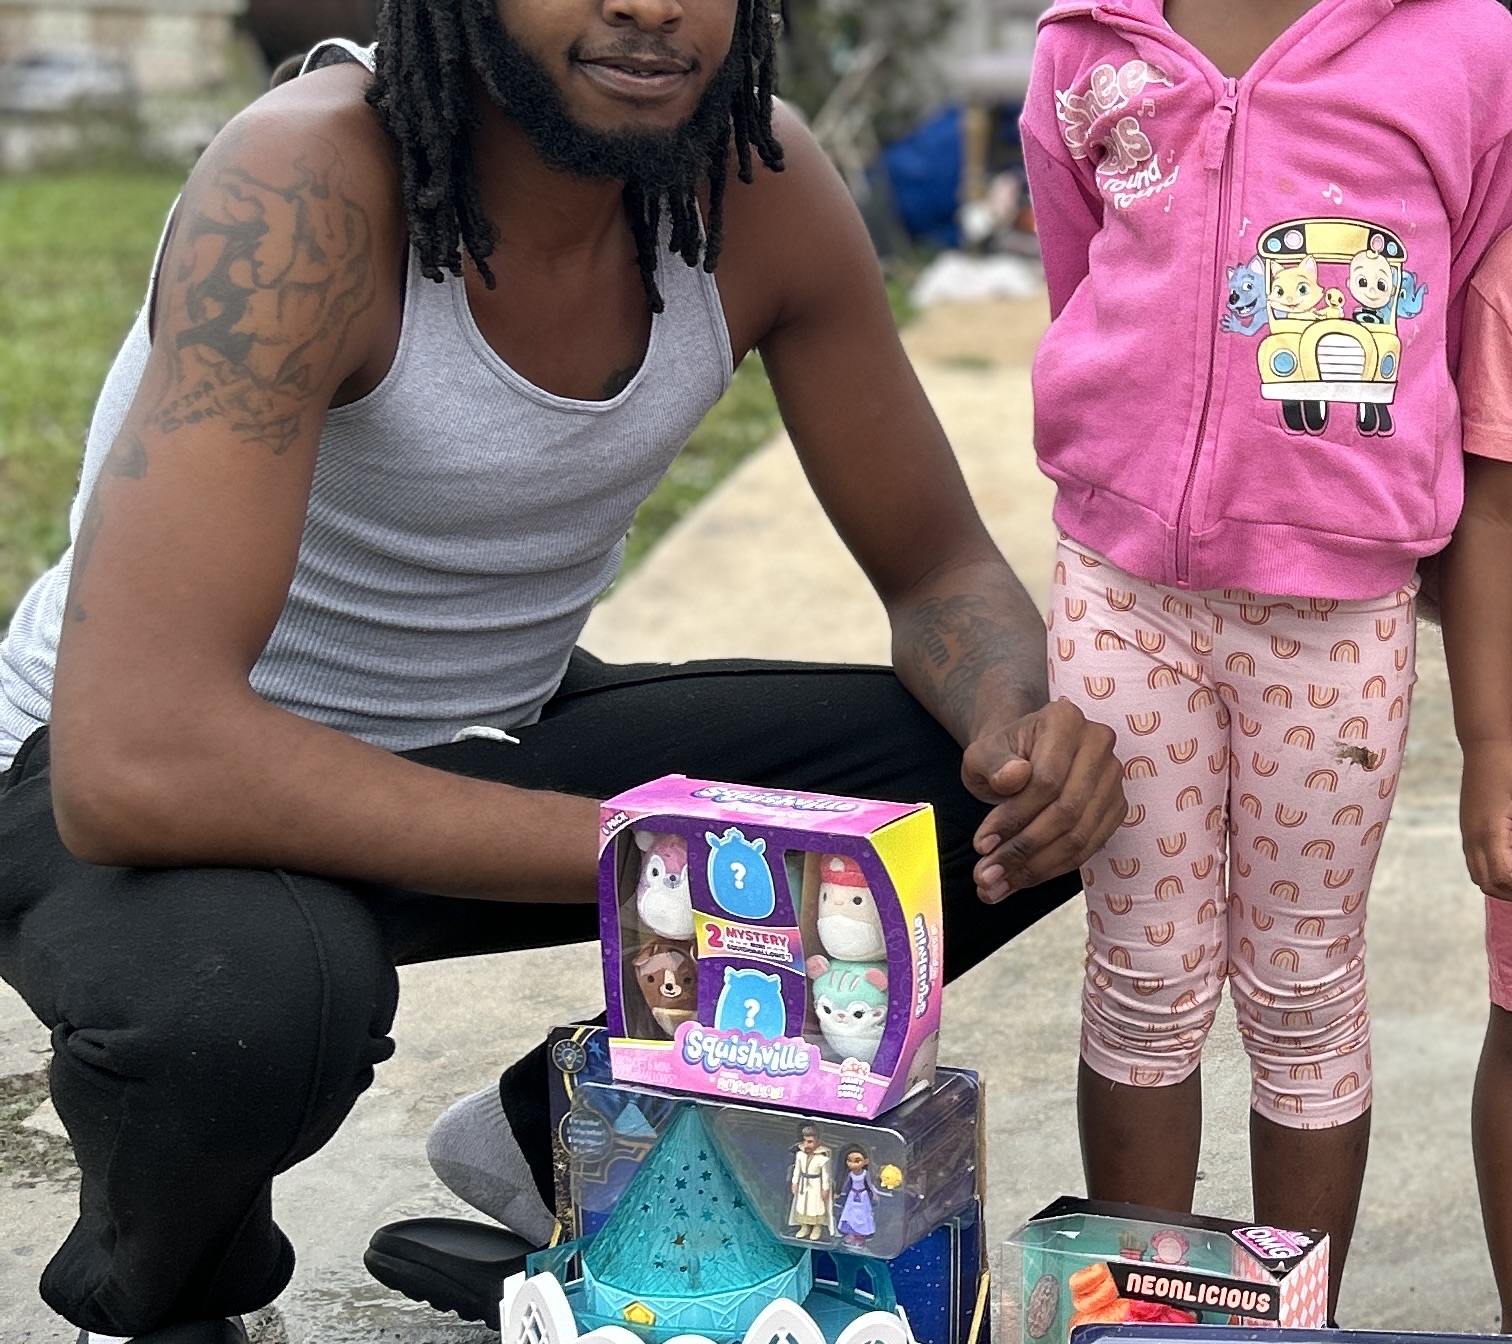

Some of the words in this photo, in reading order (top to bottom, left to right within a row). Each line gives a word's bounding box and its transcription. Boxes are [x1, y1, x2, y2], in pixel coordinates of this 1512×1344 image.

[705, 924, 723, 948] 2
[726, 927, 786, 947] MYSTERY
[684, 1029, 810, 1074] Squishville
[1127, 1272, 1270, 1312] NEONLICIOUS
